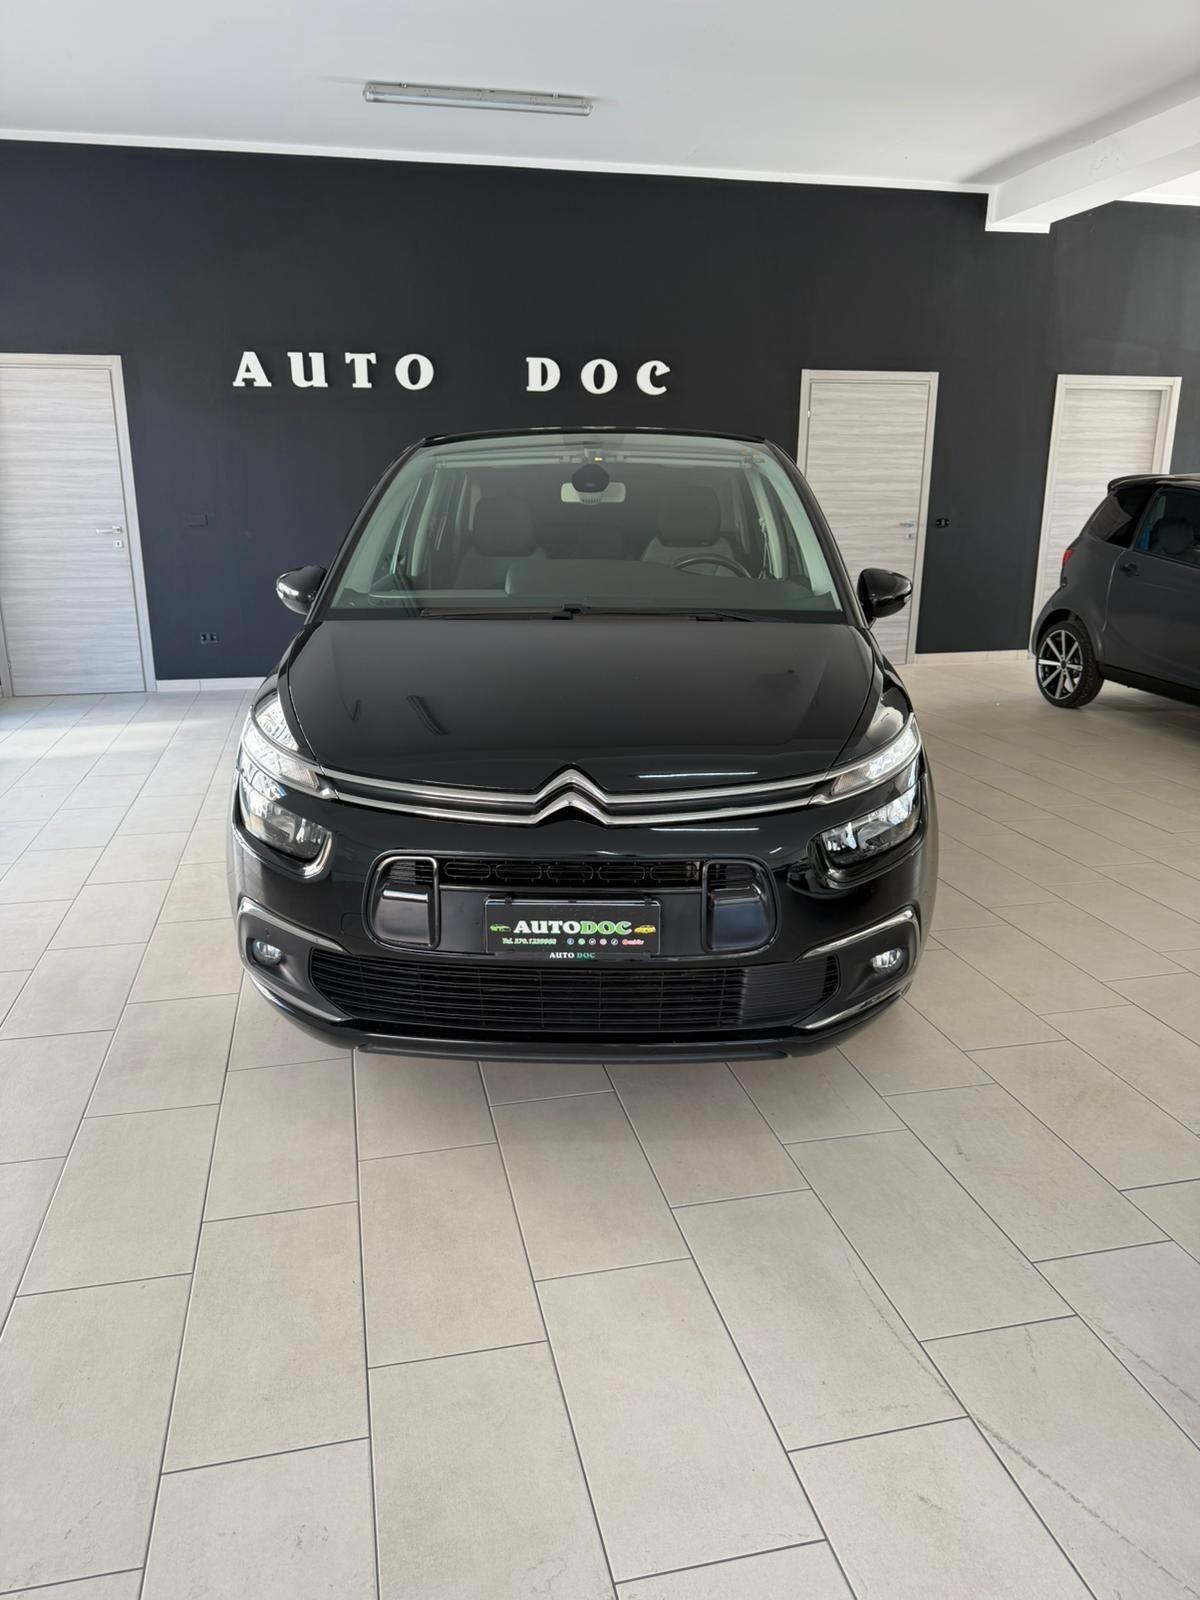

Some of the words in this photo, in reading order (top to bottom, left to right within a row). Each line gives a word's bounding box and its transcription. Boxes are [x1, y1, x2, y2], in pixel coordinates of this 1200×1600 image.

[233, 351, 434, 391] AUTO
[526, 357, 671, 395] DOC
[513, 920, 632, 935] AUTODOC
[549, 951, 575, 959] AUTO
[576, 951, 596, 959] DOC
